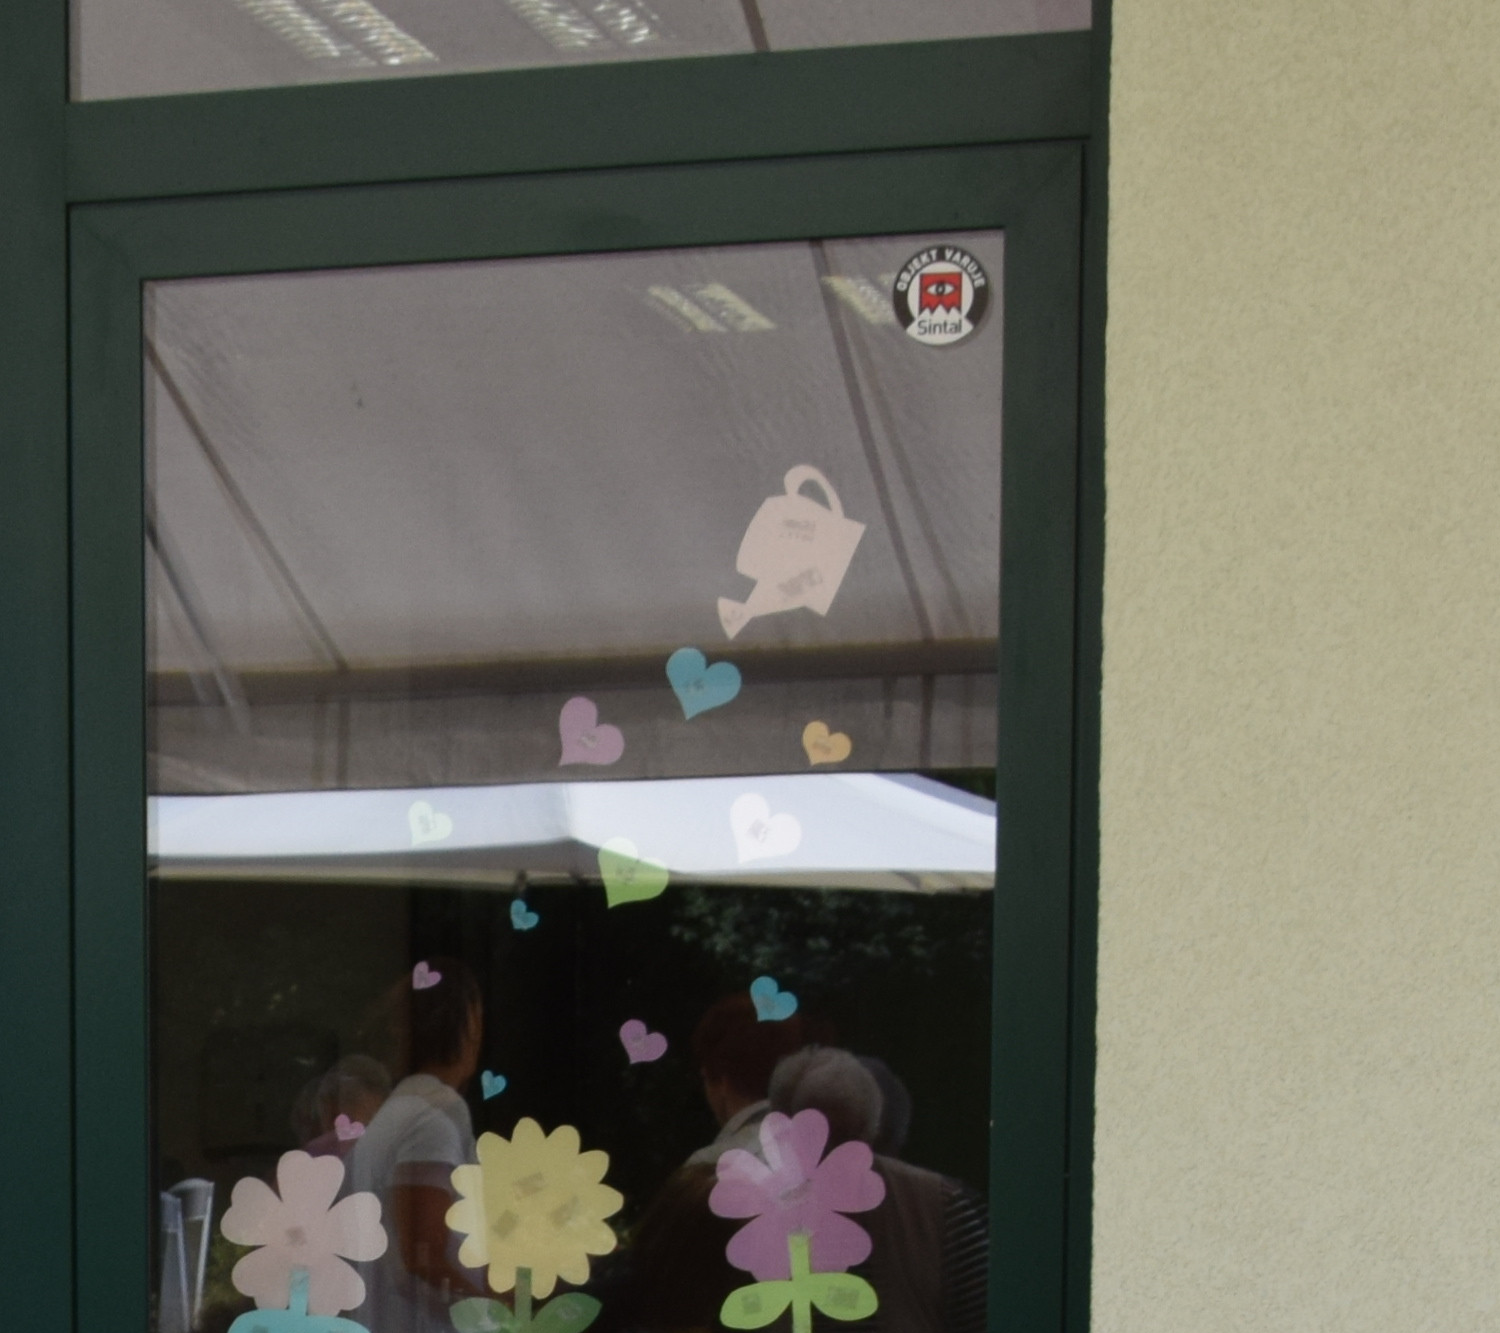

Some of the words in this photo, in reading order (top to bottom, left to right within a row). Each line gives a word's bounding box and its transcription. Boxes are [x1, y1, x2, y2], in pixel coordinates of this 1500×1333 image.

[897, 249, 938, 291] OBJEKT
[944, 249, 986, 288] VARUJE
[917, 320, 962, 335] Sintal
